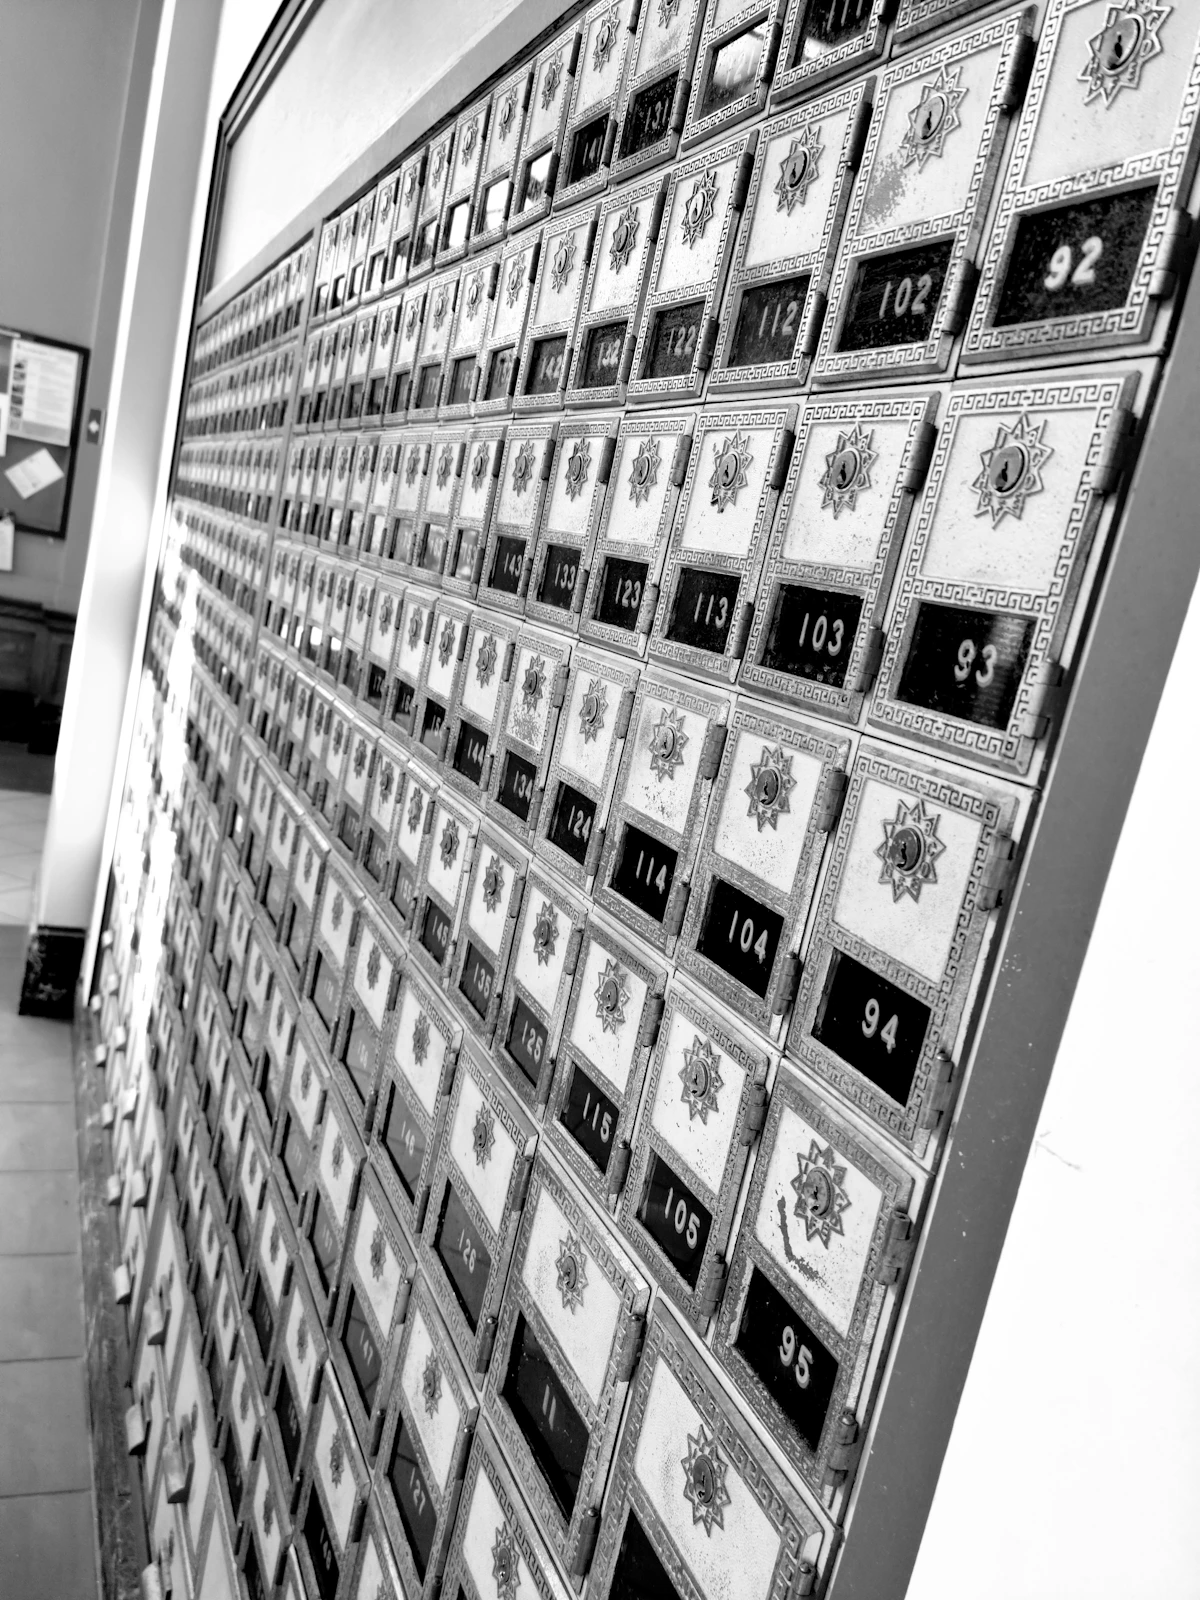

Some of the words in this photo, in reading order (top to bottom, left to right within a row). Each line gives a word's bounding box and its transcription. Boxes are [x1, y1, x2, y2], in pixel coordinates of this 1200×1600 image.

[645, 98, 669, 133] 131
[1044, 236, 1103, 290] 92
[878, 274, 933, 320] 102
[668, 324, 696, 356] 122
[758, 301, 797, 338] 112
[504, 553, 523, 577] 143
[554, 563, 576, 591] 133
[615, 578, 642, 609] 123
[693, 593, 728, 629] 113
[799, 612, 845, 656] 103
[953, 639, 998, 687] 93
[467, 738, 485, 766] 144
[513, 770, 533, 802] 134
[567, 805, 591, 843] 124
[636, 850, 668, 894] 114
[432, 916, 449, 948] 145
[728, 910, 768, 964] 104
[473, 962, 491, 1000] 135
[521, 1020, 543, 1064] 125
[861, 998, 899, 1054] 94
[583, 1092, 613, 1143] 115
[664, 1187, 700, 1249] 105
[458, 1229, 477, 1274] 126
[779, 1326, 814, 1389] 95
[542, 1384, 557, 1431] 11
[410, 1467, 426, 1516] 127
